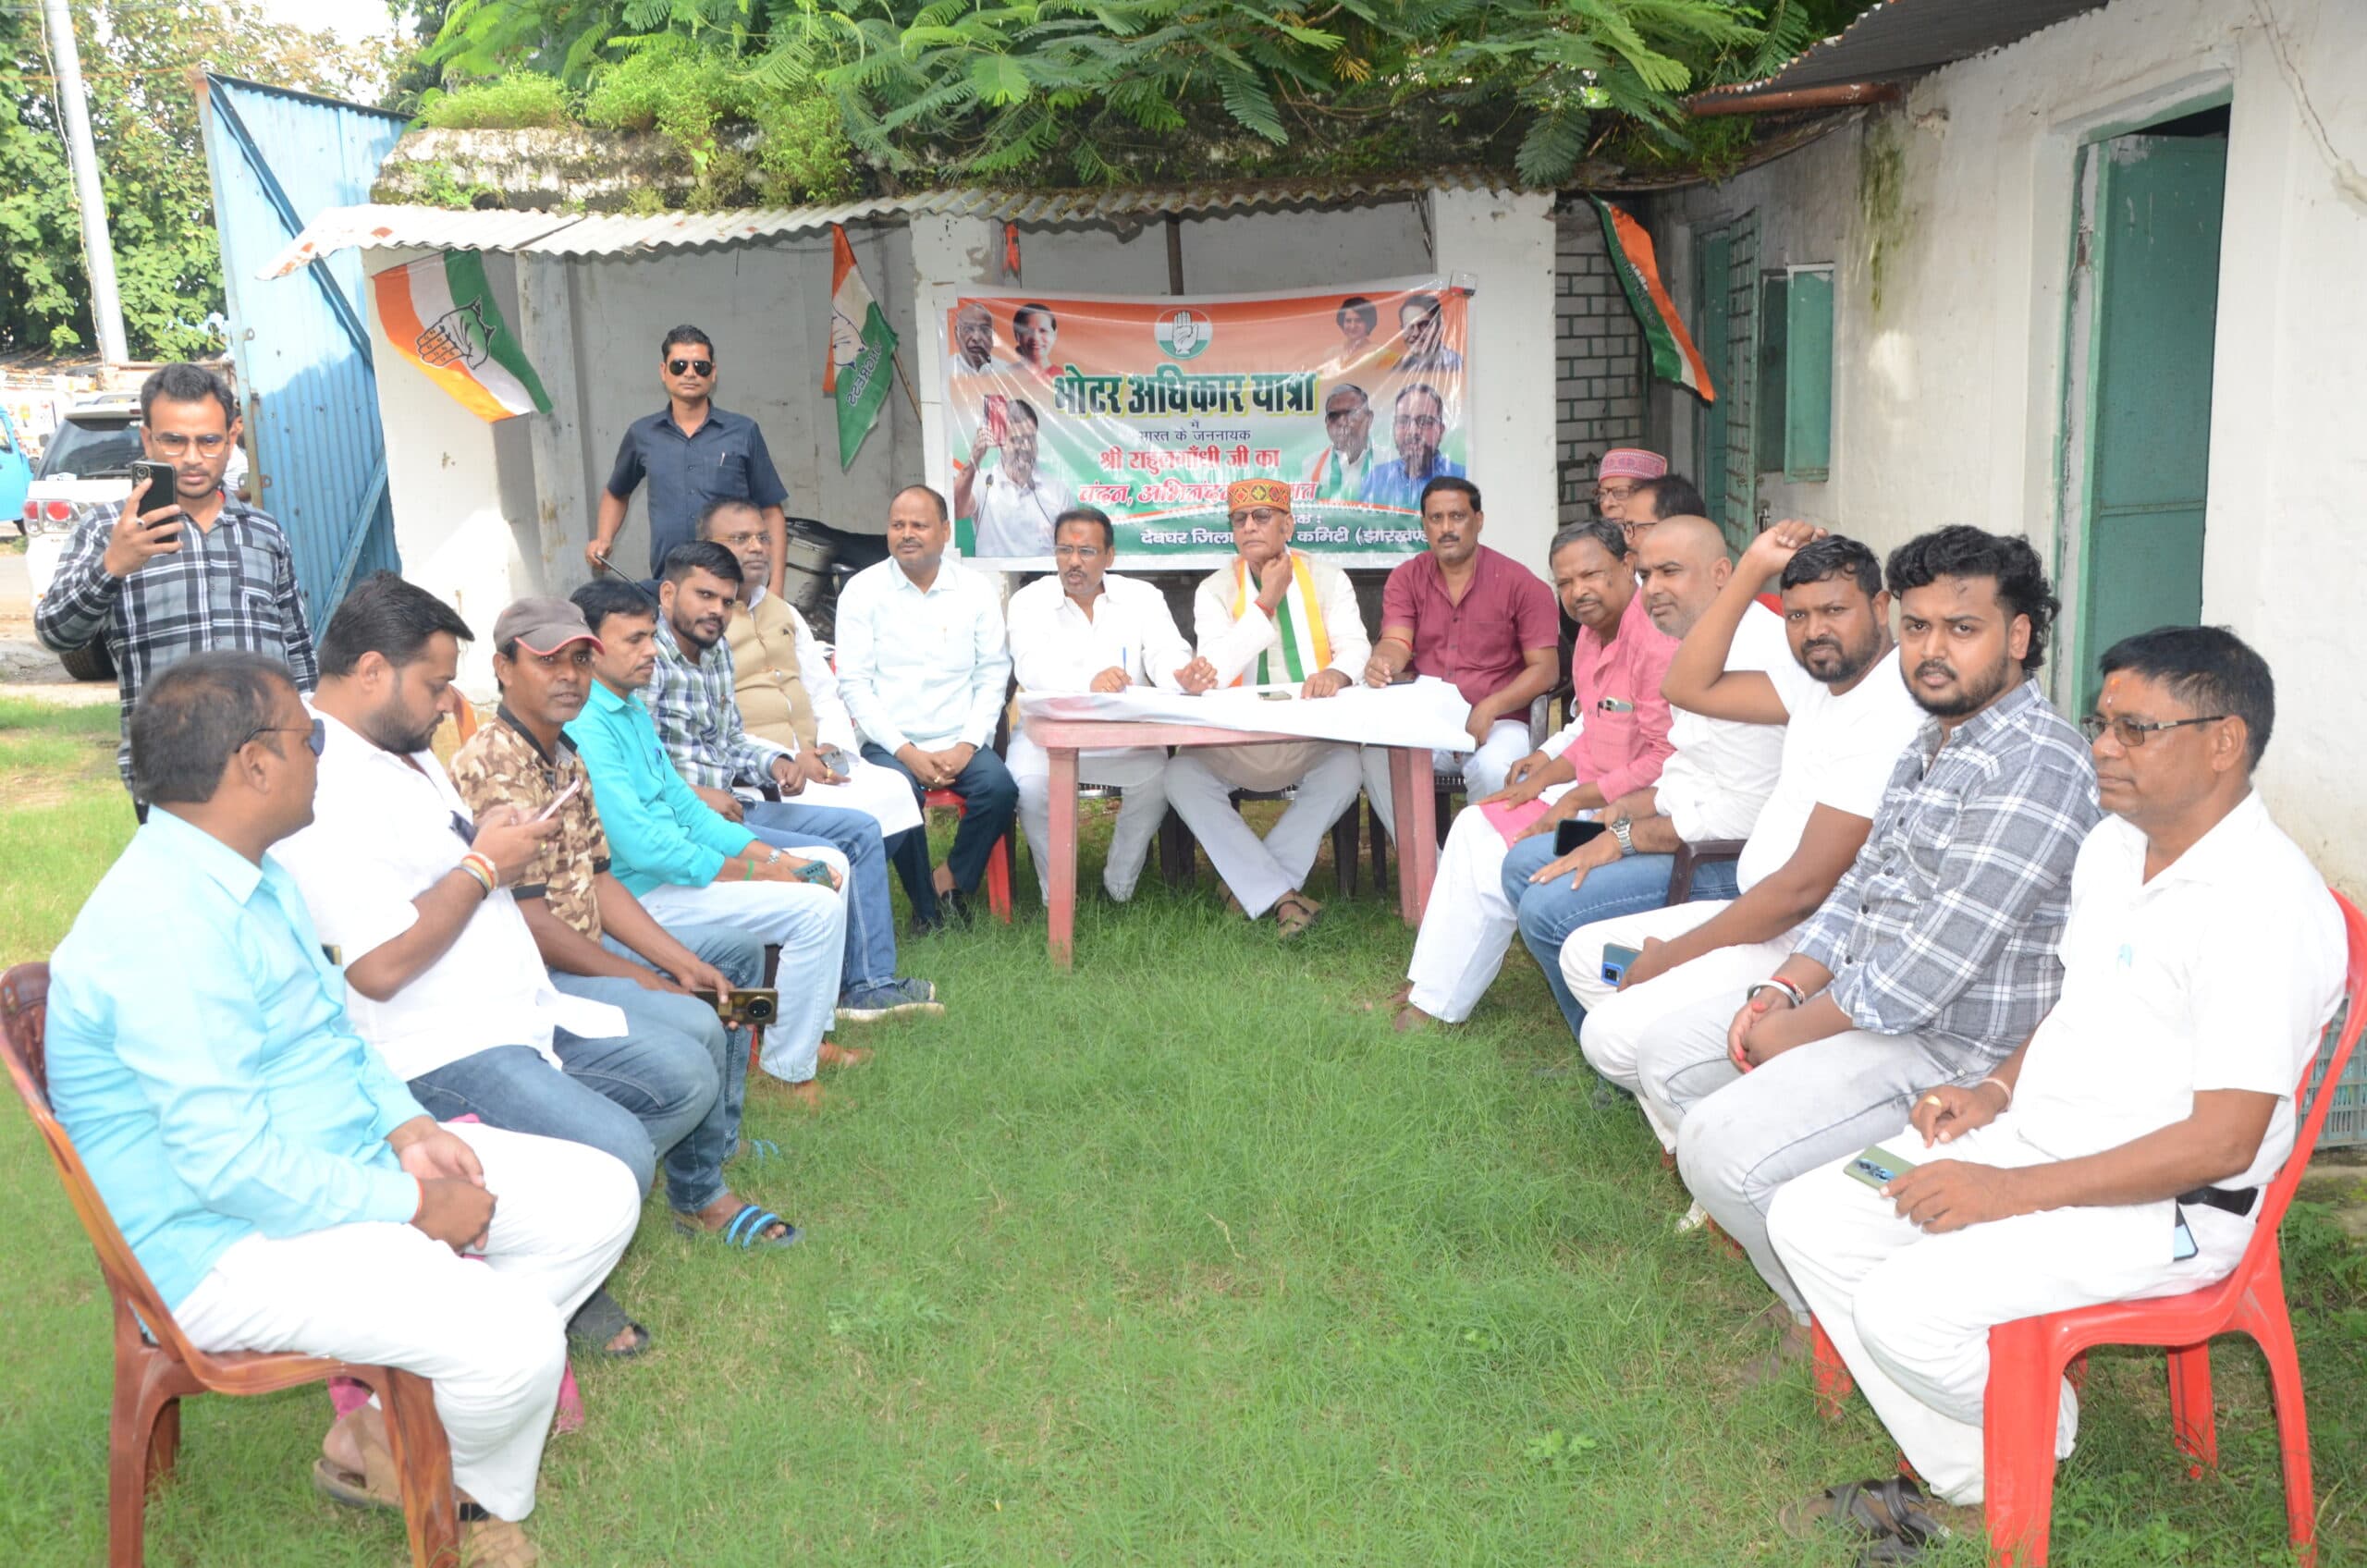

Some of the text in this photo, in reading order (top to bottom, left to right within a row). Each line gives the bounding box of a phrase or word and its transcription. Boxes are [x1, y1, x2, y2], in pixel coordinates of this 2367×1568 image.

[1128, 363, 1246, 414] अधिकार
[1250, 373, 1318, 413] यात्रा
[1173, 426, 1188, 442] के
[1192, 429, 1252, 442] जननायक
[1100, 446, 1123, 470] श्री
[1225, 445, 1250, 468] जी
[1255, 449, 1281, 469] का
[1296, 526, 1349, 543] कमिटी
